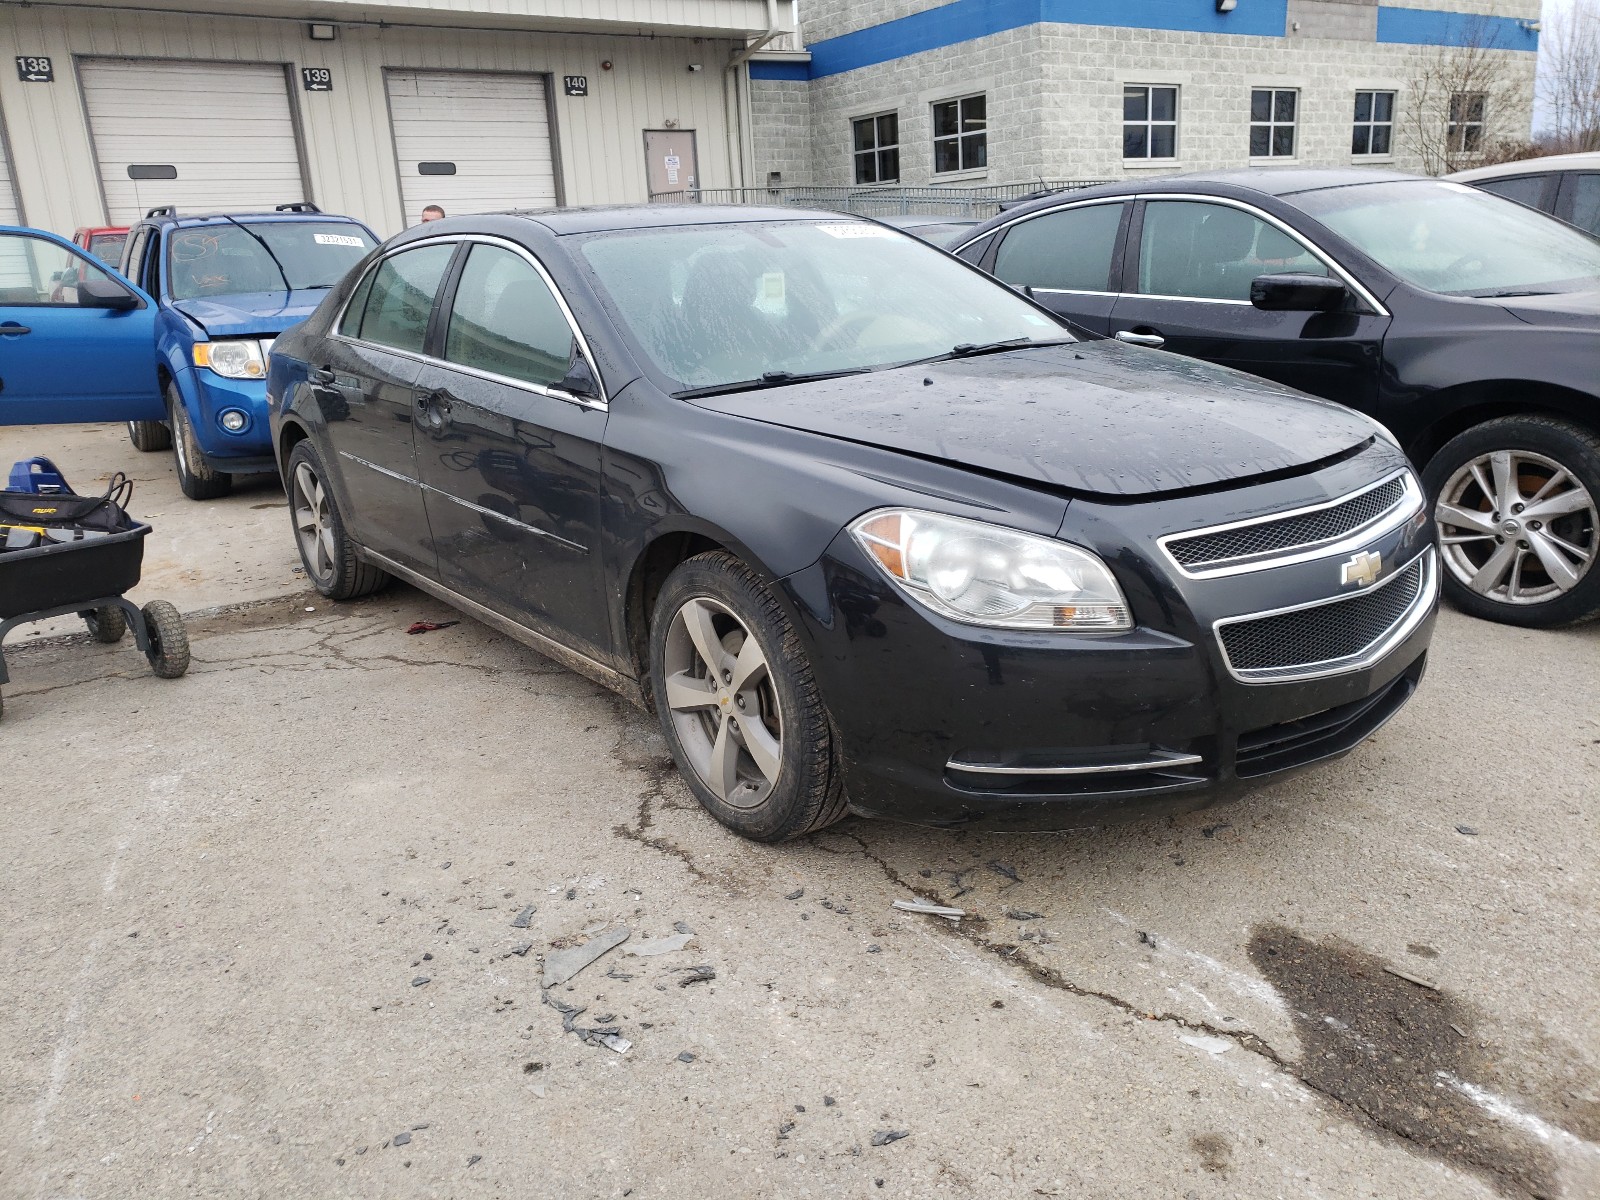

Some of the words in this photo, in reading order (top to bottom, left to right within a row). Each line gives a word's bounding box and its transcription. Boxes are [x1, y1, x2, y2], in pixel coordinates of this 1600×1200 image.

[18, 58, 50, 71] 138
[304, 70, 329, 81] 139
[566, 77, 585, 88] 140
